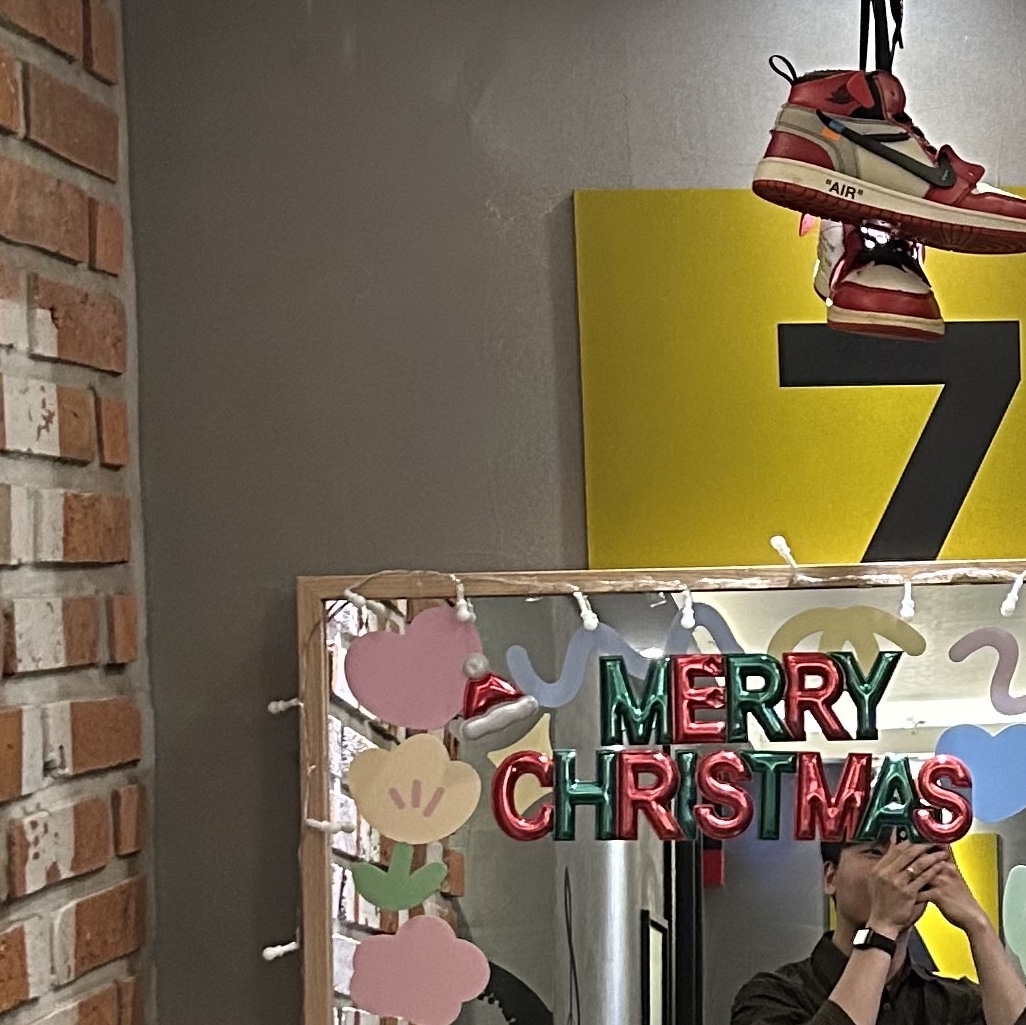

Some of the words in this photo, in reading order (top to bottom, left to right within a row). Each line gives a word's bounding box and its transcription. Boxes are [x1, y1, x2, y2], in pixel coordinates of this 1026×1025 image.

[777, 320, 1021, 563] 7
[600, 651, 902, 746] MERRY
[491, 749, 973, 844] CHRISTMAS
